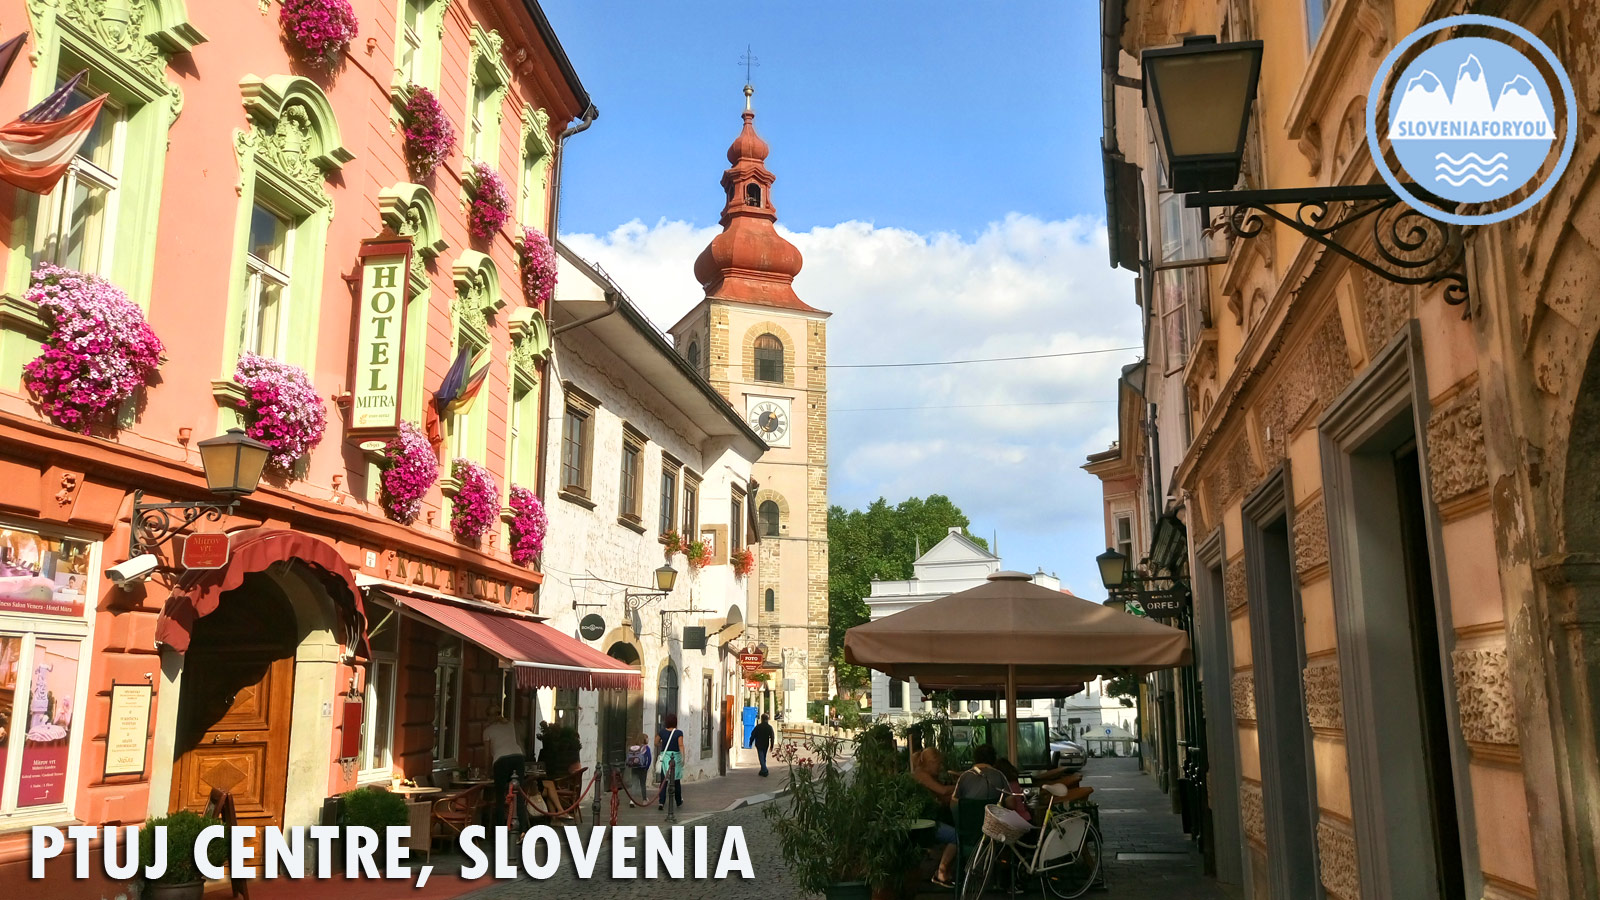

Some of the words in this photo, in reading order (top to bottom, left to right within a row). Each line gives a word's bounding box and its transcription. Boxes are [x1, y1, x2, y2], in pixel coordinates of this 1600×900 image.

[368, 265, 398, 391] HOTEL
[356, 395, 396, 409] MITRA
[1146, 601, 1180, 610] ORFEJ
